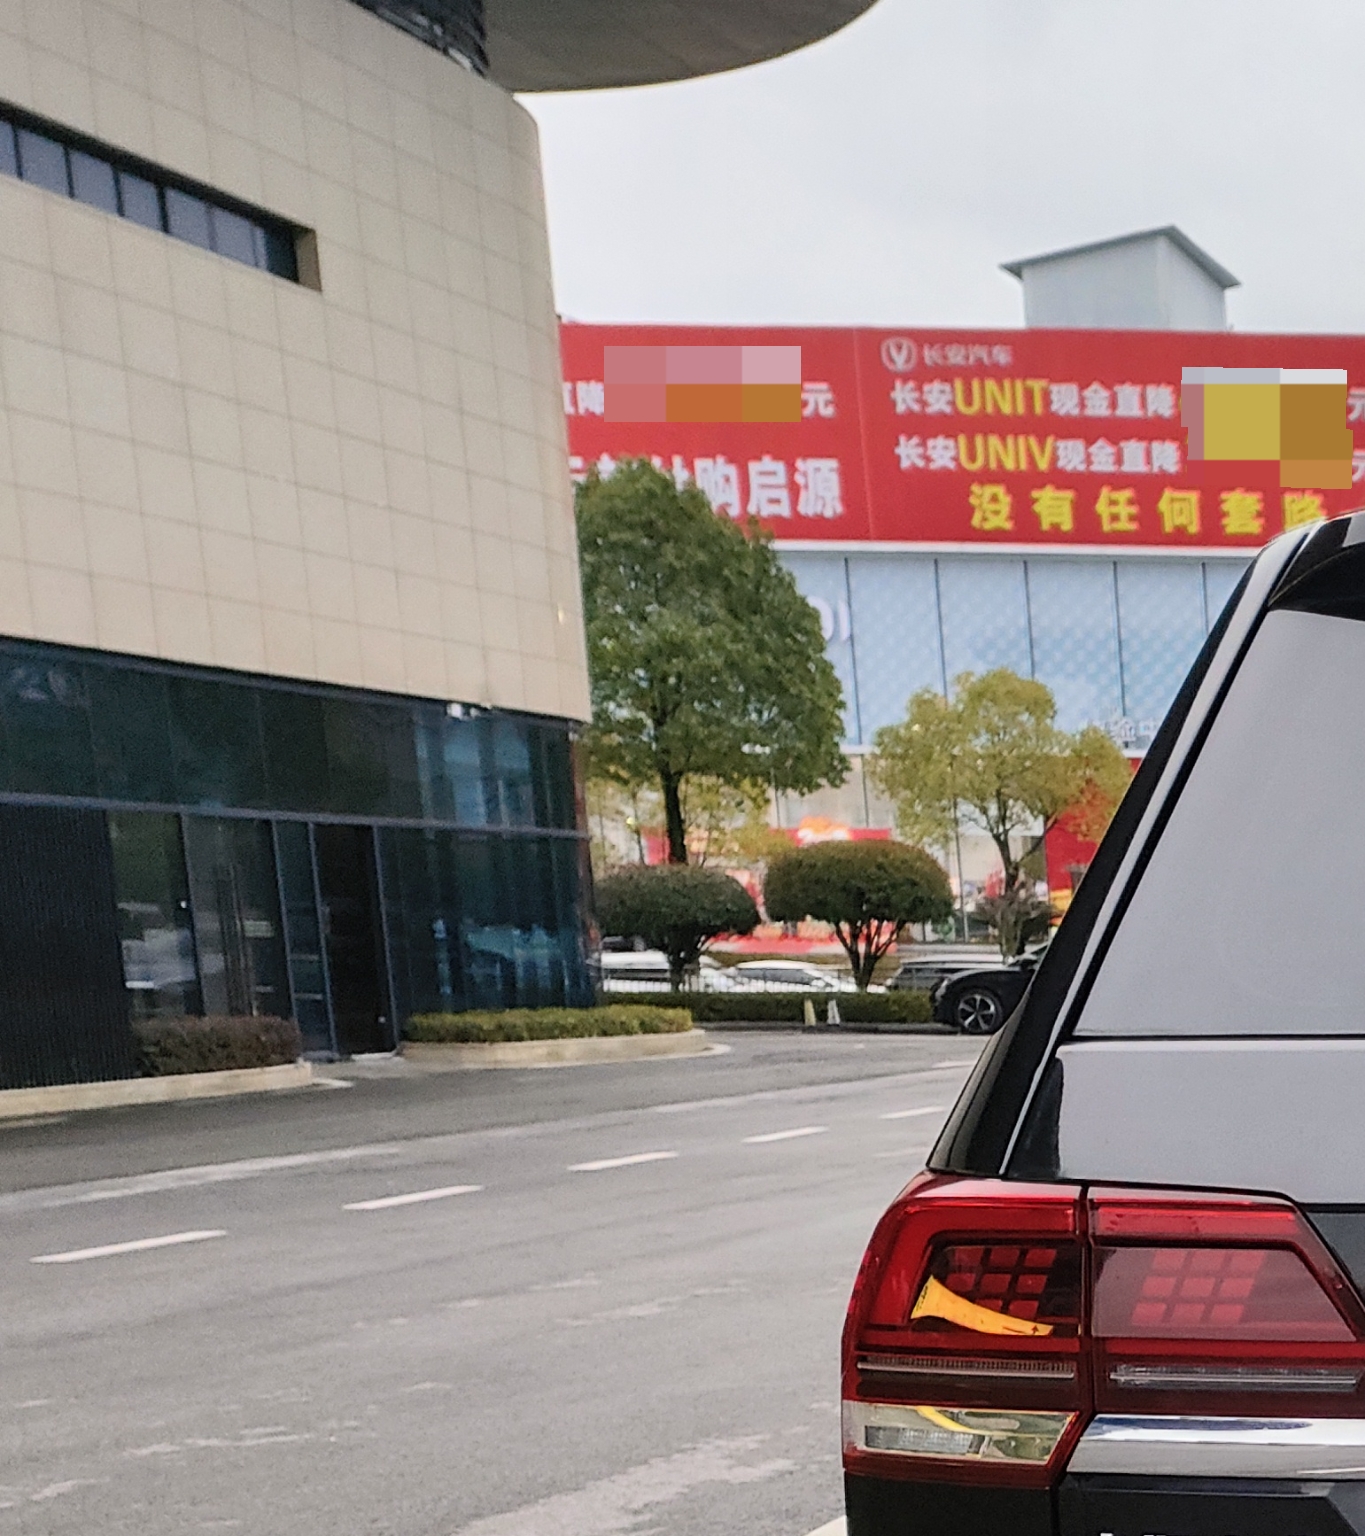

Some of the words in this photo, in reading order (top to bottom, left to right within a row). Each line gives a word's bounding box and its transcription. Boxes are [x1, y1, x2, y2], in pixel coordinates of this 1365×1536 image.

[923, 344, 1012, 366] 长安汽车
[801, 381, 835, 417] 元
